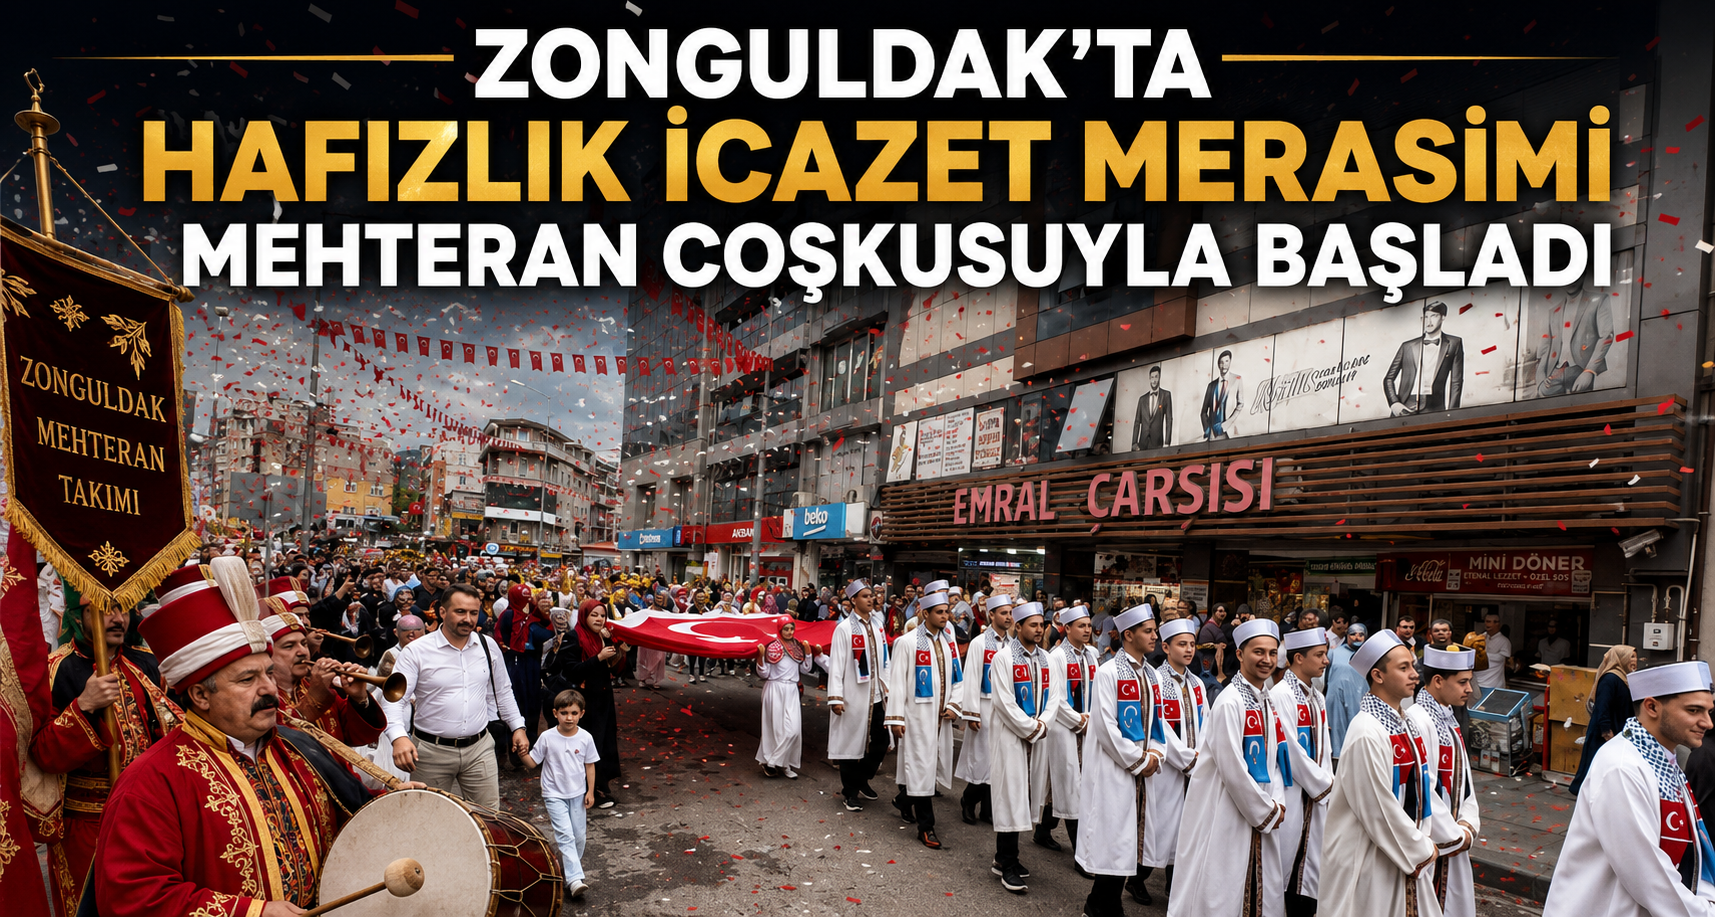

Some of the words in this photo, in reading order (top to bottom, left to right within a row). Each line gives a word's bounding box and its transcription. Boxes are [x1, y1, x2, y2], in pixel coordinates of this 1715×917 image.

[20, 355, 167, 423] ZONGULDAK
[36, 416, 165, 473] MEHTERAN
[58, 474, 141, 516] TAKIMI
[804, 507, 829, 525] beko
[953, 480, 1056, 525] EMRAL
[1468, 553, 1506, 570] MİNİ
[1512, 552, 1585, 571] DÖNER
[1552, 573, 1570, 582] SOS
